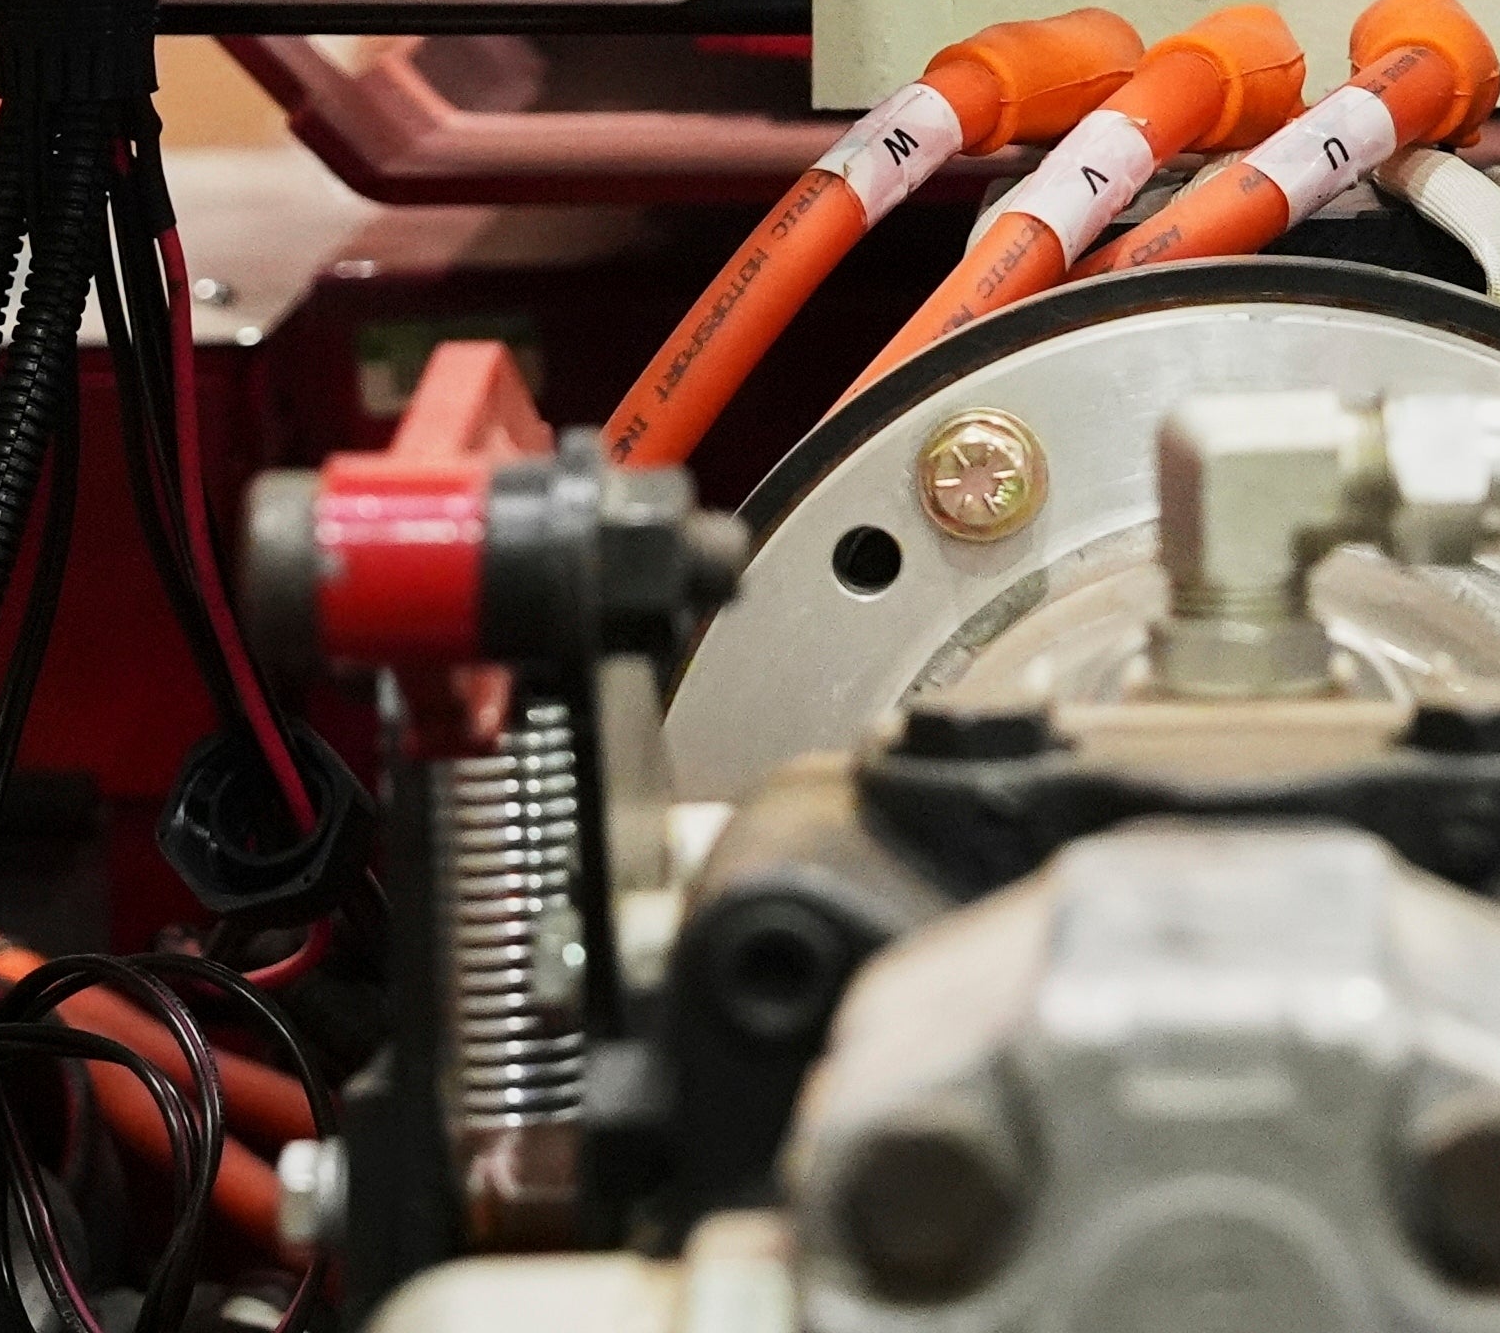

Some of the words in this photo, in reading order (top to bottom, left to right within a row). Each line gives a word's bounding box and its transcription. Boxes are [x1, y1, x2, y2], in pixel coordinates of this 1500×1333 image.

[883, 126, 920, 167] W
[1322, 136, 1350, 171] U
[1080, 165, 1110, 196] V
[652, 247, 770, 404] MOTORSPORT
[610, 414, 649, 464] INC
